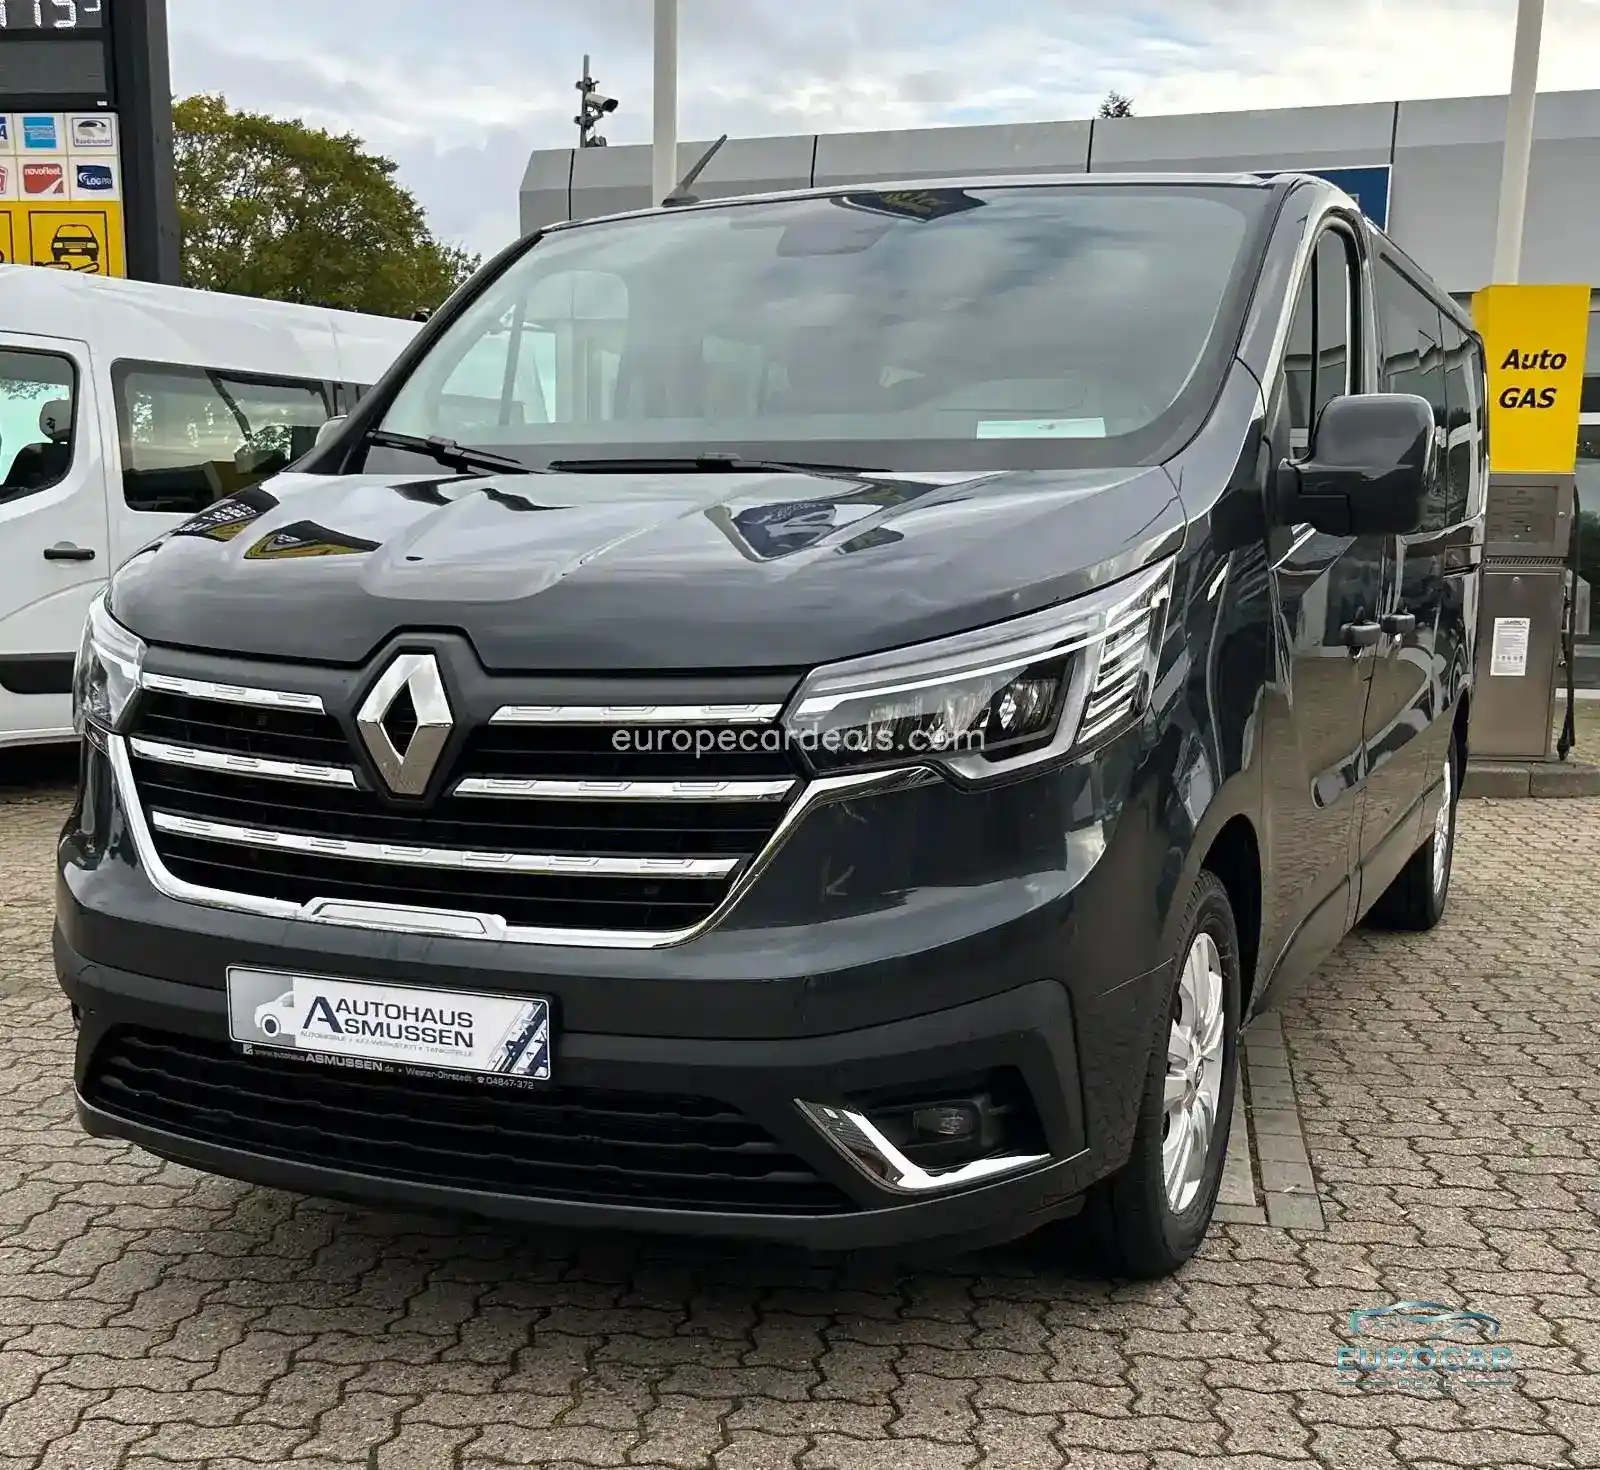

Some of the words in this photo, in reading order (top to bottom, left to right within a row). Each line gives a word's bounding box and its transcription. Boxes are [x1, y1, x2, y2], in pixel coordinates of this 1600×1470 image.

[1500, 348, 1567, 370] Auto
[1499, 387, 1557, 408] GAS
[335, 998, 473, 1028] AUTOHAUS
